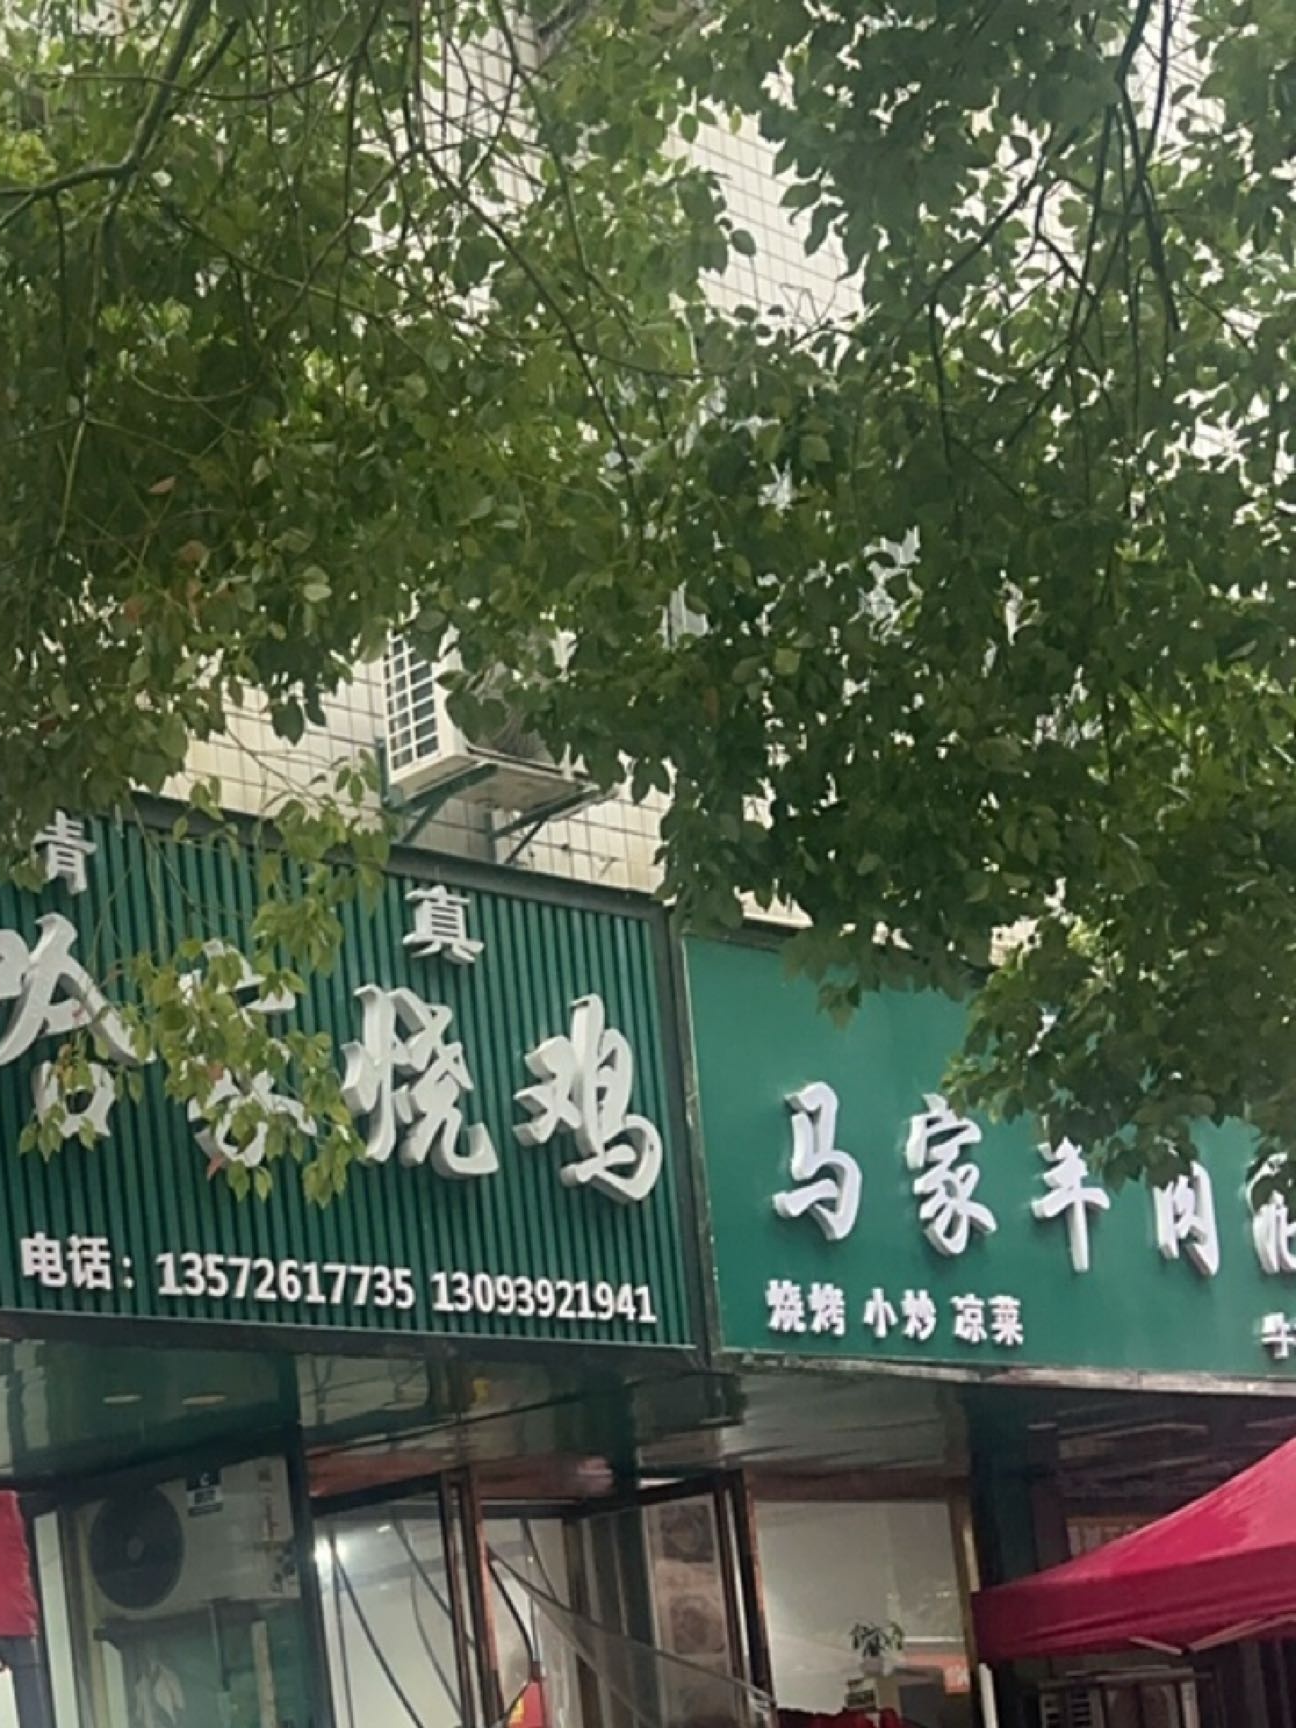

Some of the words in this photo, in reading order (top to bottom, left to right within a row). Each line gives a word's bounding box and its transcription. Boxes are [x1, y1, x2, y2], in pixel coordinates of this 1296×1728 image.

[403, 884, 484, 966] 真
[155, 1250, 415, 1311] 13572617735
[431, 1270, 657, 1325] 13093921941
[765, 1279, 846, 1336] 烧烤
[862, 1286, 937, 1342] 小炒
[950, 1294, 1025, 1347] 凉菜
